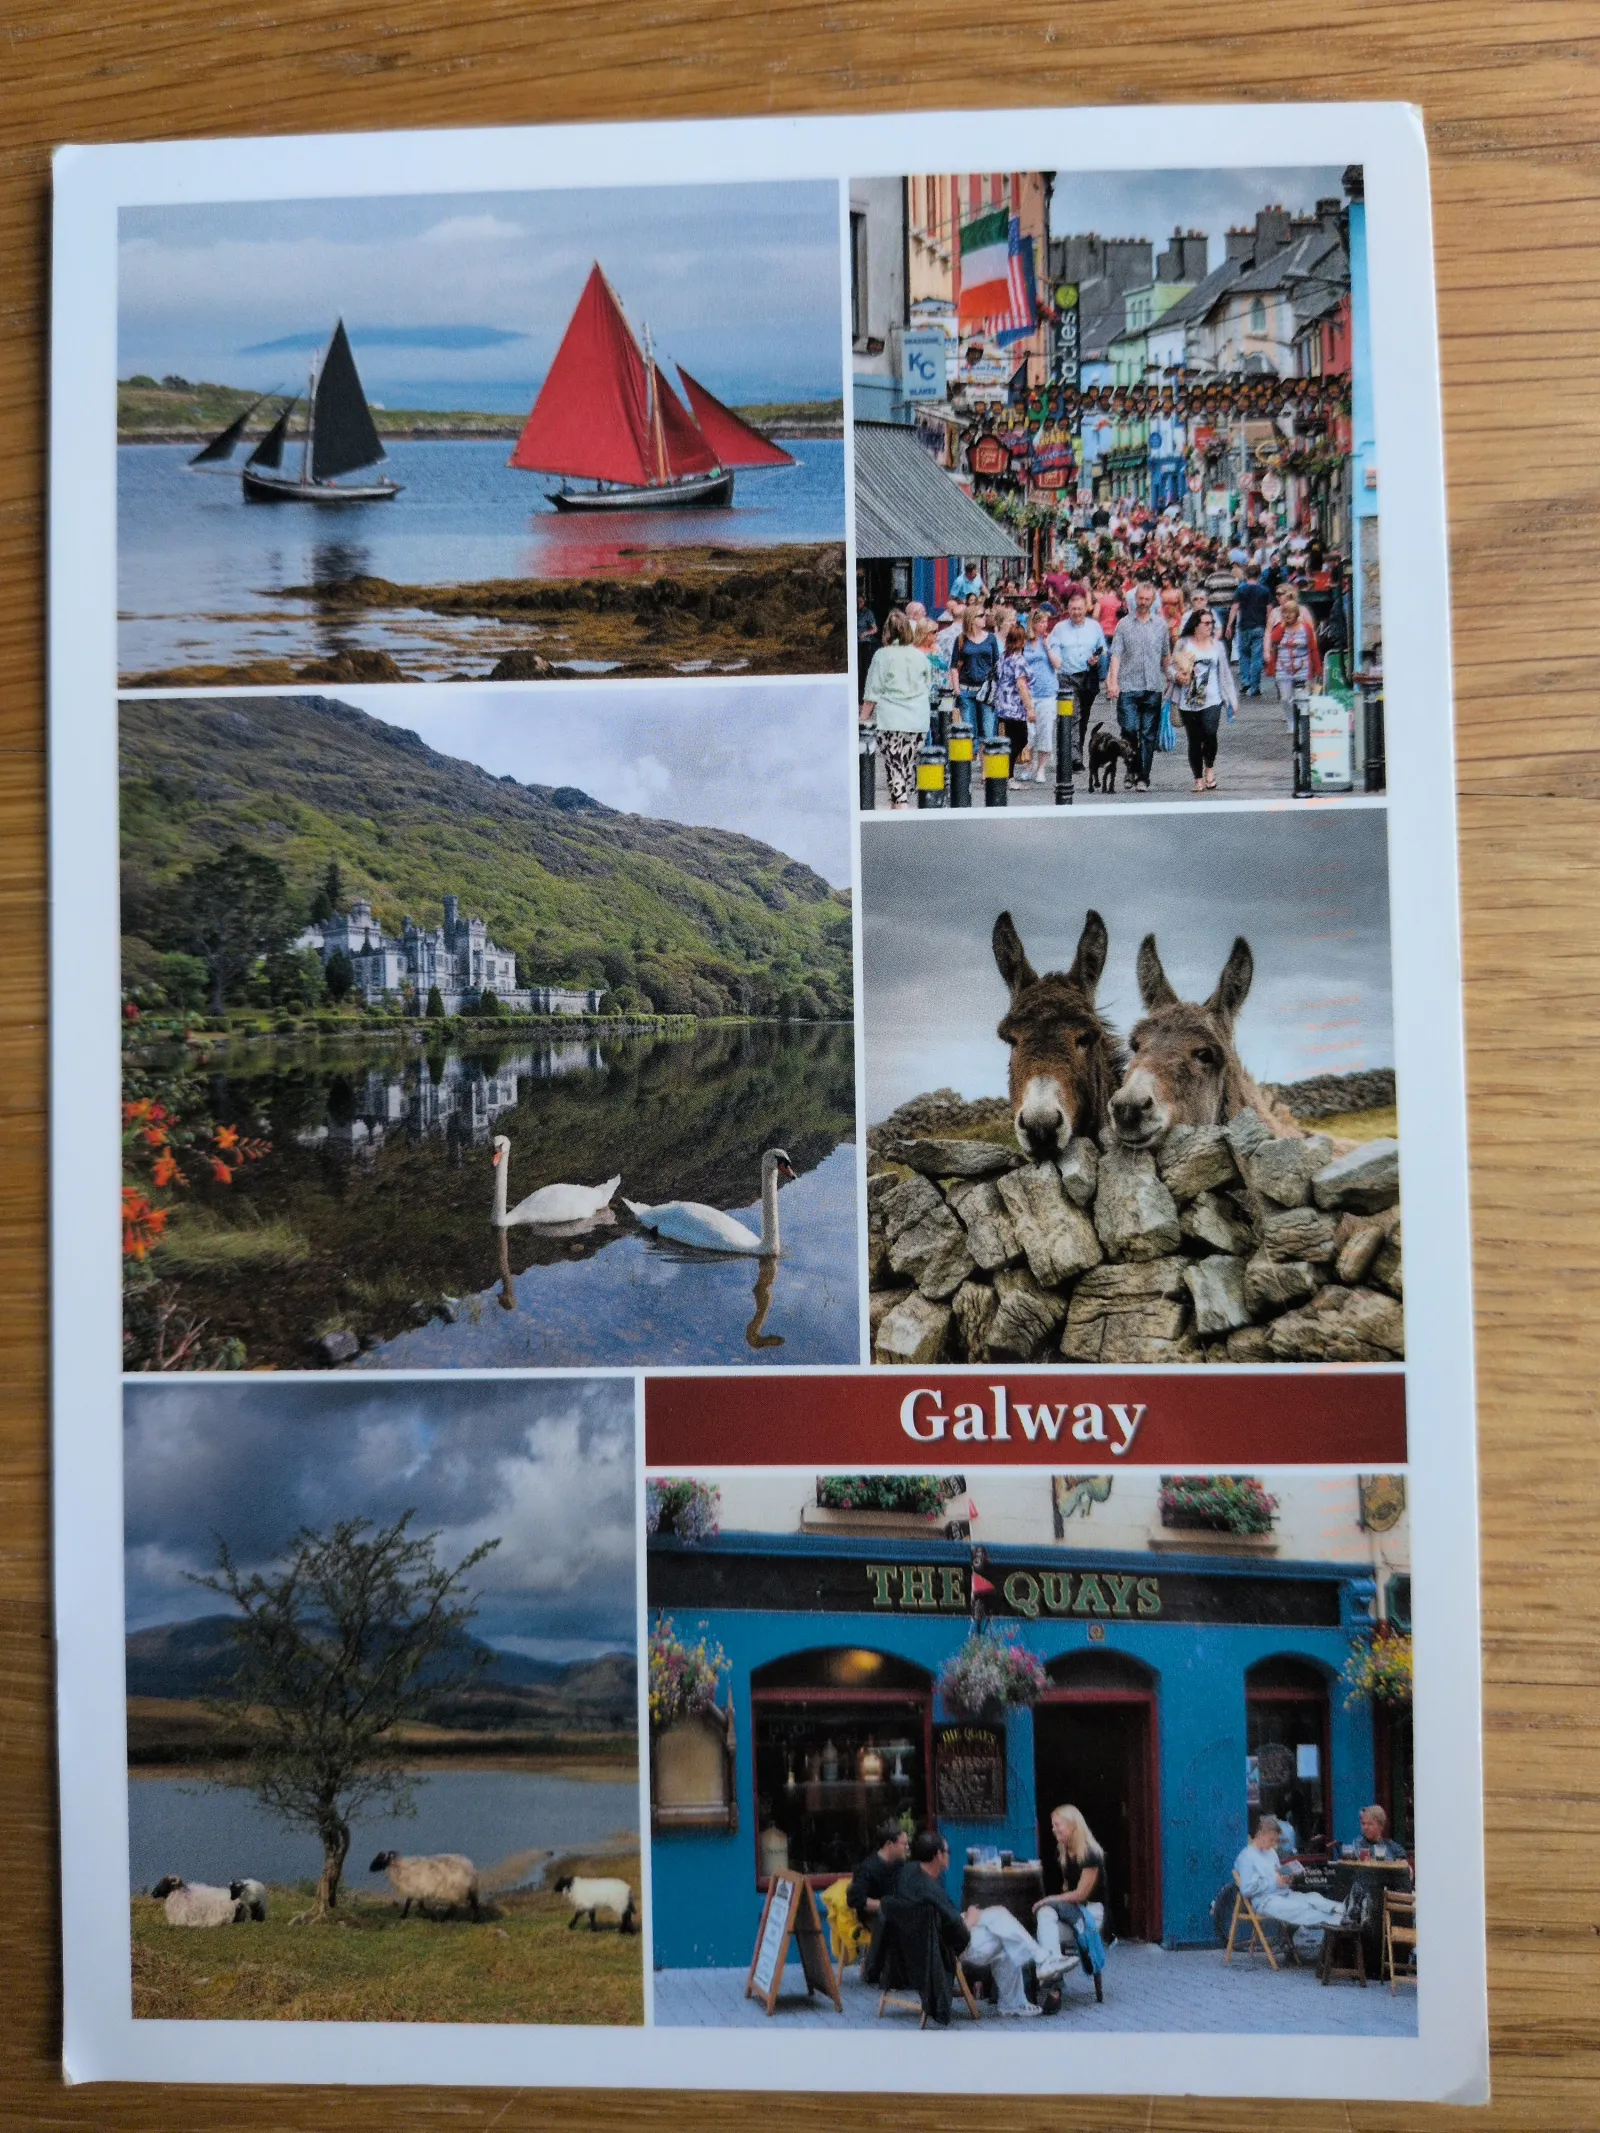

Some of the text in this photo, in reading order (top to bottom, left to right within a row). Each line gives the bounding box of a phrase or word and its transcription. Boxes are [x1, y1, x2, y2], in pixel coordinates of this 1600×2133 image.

[908, 352, 936, 381] KC
[899, 1385, 1148, 1456] Galway
[866, 1564, 1162, 1617] THE QUAYS
